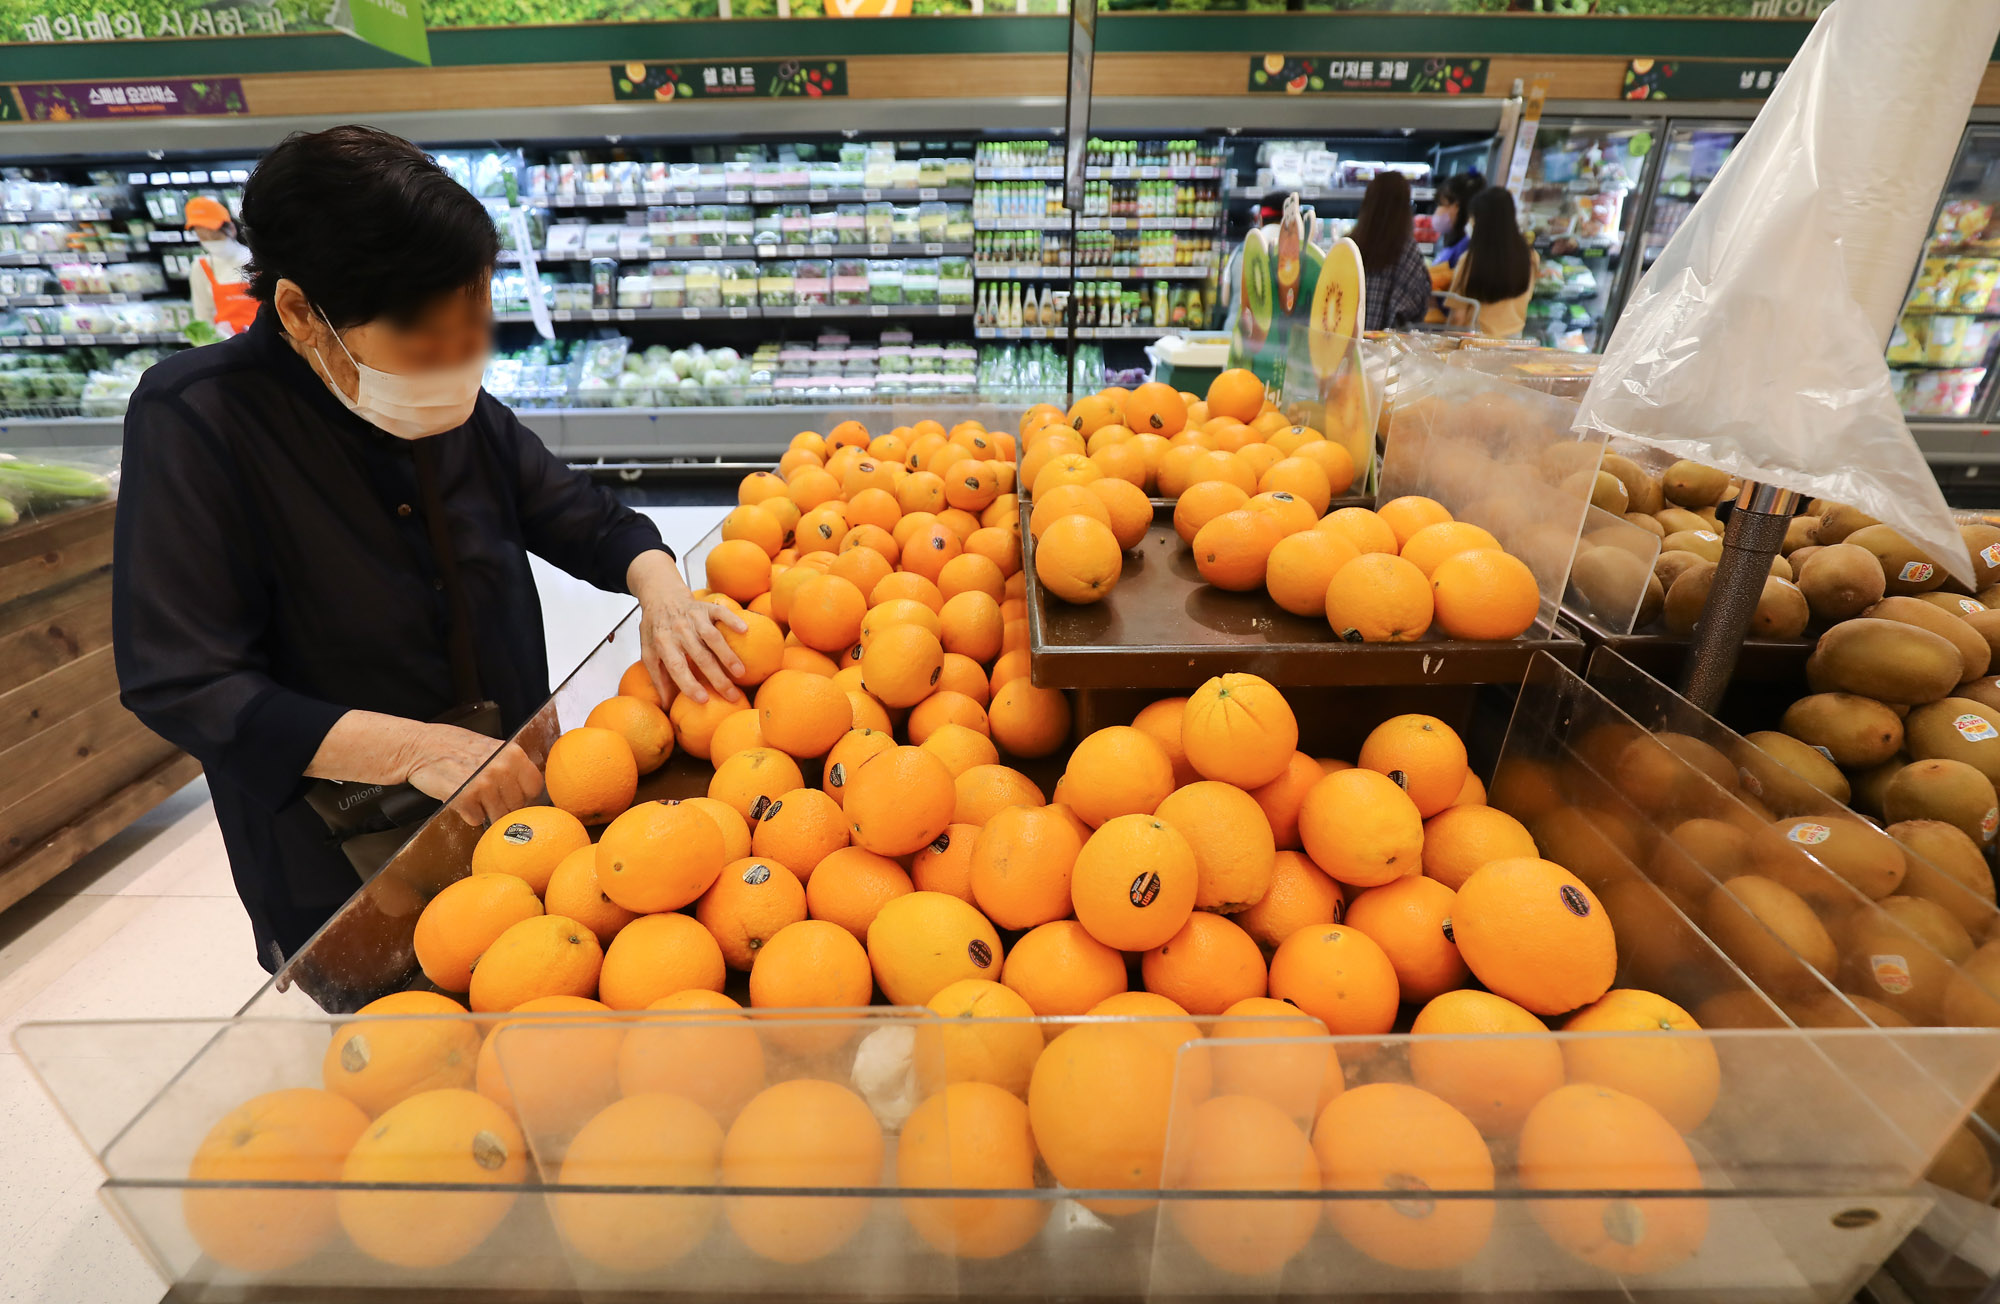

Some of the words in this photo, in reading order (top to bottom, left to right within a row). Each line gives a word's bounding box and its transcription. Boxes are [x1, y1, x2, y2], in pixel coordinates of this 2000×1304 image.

[1329, 61, 1374, 80] 디저트
[1379, 61, 1409, 81] 과일
[338, 784, 383, 811] Unione
